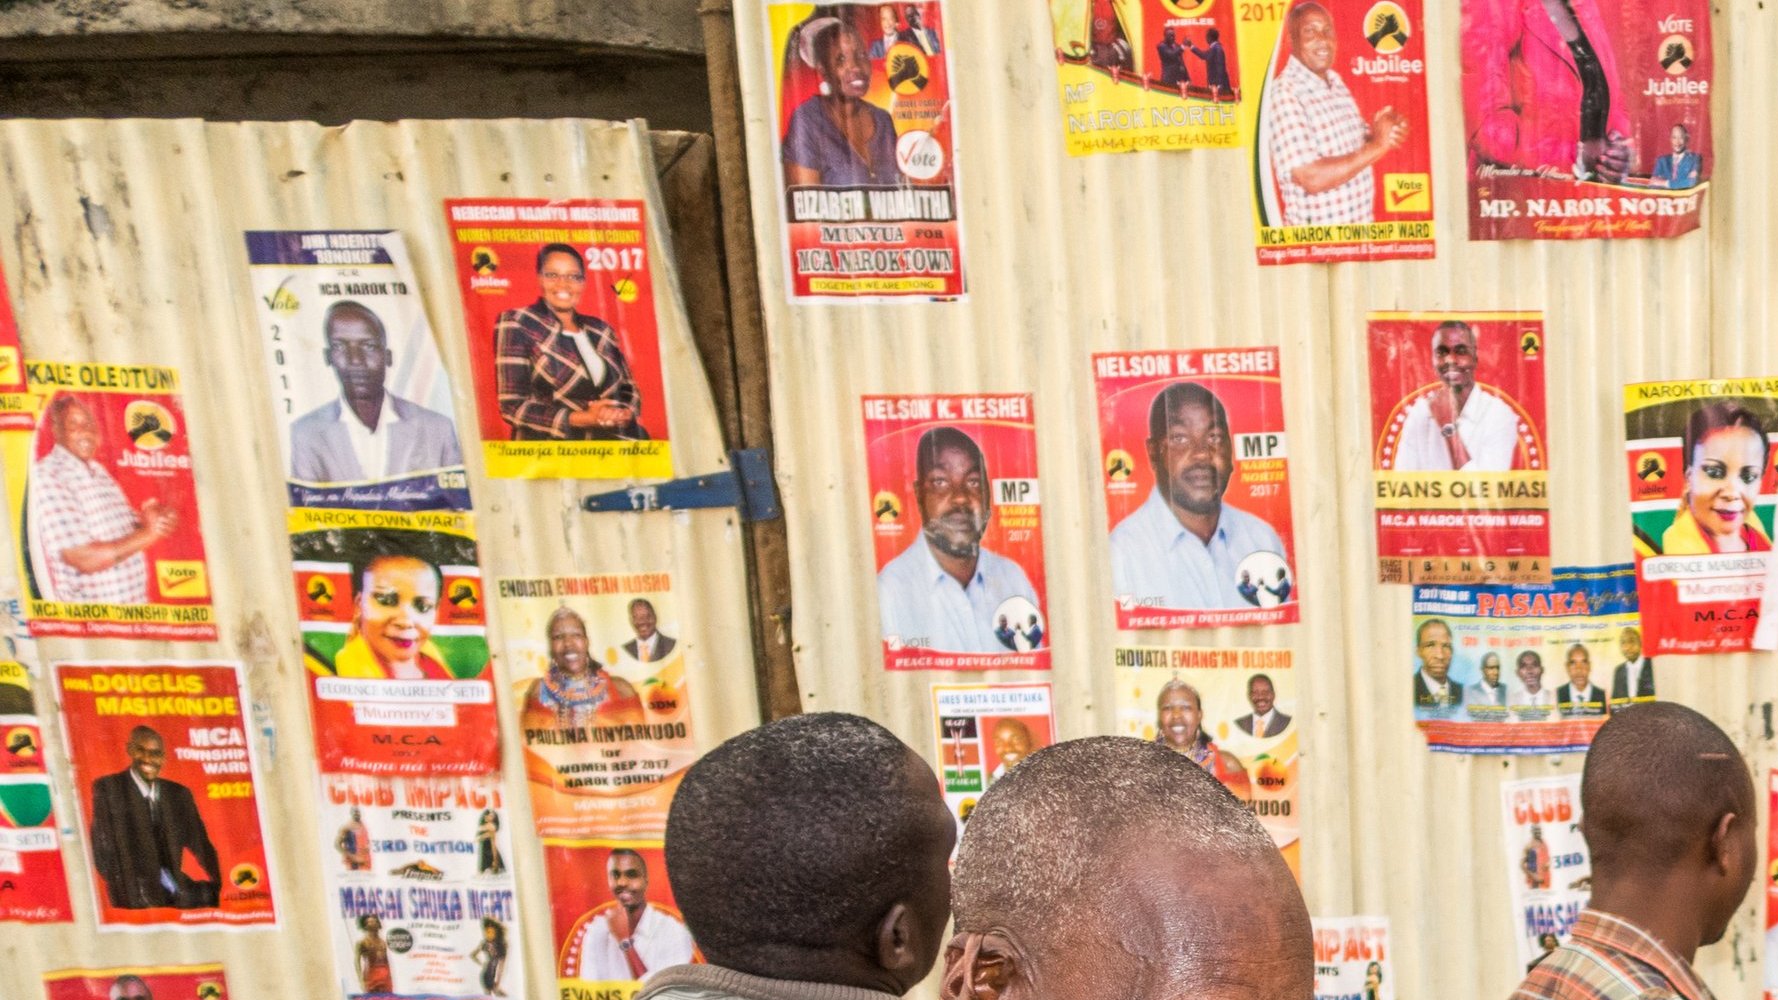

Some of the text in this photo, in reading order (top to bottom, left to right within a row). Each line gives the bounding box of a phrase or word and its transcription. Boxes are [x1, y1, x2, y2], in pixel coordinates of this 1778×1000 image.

[1164, 17, 1216, 27] JUBILEE
[1657, 14, 1693, 33] VOTE
[1351, 55, 1424, 74] Jubilee
[1065, 83, 1094, 105] MP
[1643, 78, 1708, 96] Jubilee
[1068, 106, 1236, 133] NAROK NORTH
[1131, 135, 1161, 147] FOR
[1396, 180, 1423, 190] Vote
[1480, 196, 1698, 217] MP. NAROK NORTH
[822, 227, 944, 242] MUNYUA FOR
[1261, 224, 1429, 243] MCA NAROK TOWNSHIP WARD
[586, 248, 643, 271] 2017
[840, 250, 901, 272] NAROK
[905, 249, 952, 272] TOWN
[345, 283, 387, 295] NAROK
[865, 280, 900, 289] WE ARE
[1096, 351, 1274, 377] NELSON K. KESHEI
[80, 366, 117, 388] OLE
[1638, 382, 1746, 398] NAROK TOWN
[865, 400, 932, 420] NELSON
[938, 400, 957, 418] K.
[1242, 434, 1278, 458] MP
[118, 451, 190, 469] Jubilee
[1002, 480, 1030, 502] MP
[1250, 484, 1280, 498] 2017
[1377, 480, 1546, 498] EVANS OLE MASI
[305, 512, 415, 527] NAROK TOWN
[1419, 515, 1544, 526] NAROK TOWN WARD
[167, 568, 197, 578] Vote
[1136, 596, 1166, 606] VOTE
[1476, 593, 1590, 617] PASAKA
[1129, 612, 1286, 628] PEACE AND DEVELOPMENT
[1694, 610, 1759, 622] M.C.A
[902, 638, 930, 648] VOTE
[1242, 652, 1292, 669] OLOSHO
[92, 675, 204, 693] DOUGLAS
[453, 685, 486, 698] SETH
[95, 697, 238, 716] MASIKONDE
[189, 727, 244, 746] MCA
[372, 734, 441, 747] M.C.A
[175, 748, 245, 761] TOWNSHIP
[203, 763, 249, 774] WARD
[610, 762, 638, 772] REP
[208, 782, 252, 799] 2017
[392, 810, 452, 822] PRESENTS
[16, 832, 52, 846] SETH
[414, 840, 474, 854] EDITION
[1553, 855, 1585, 868] 3RD
[408, 888, 463, 920] SHUKA
